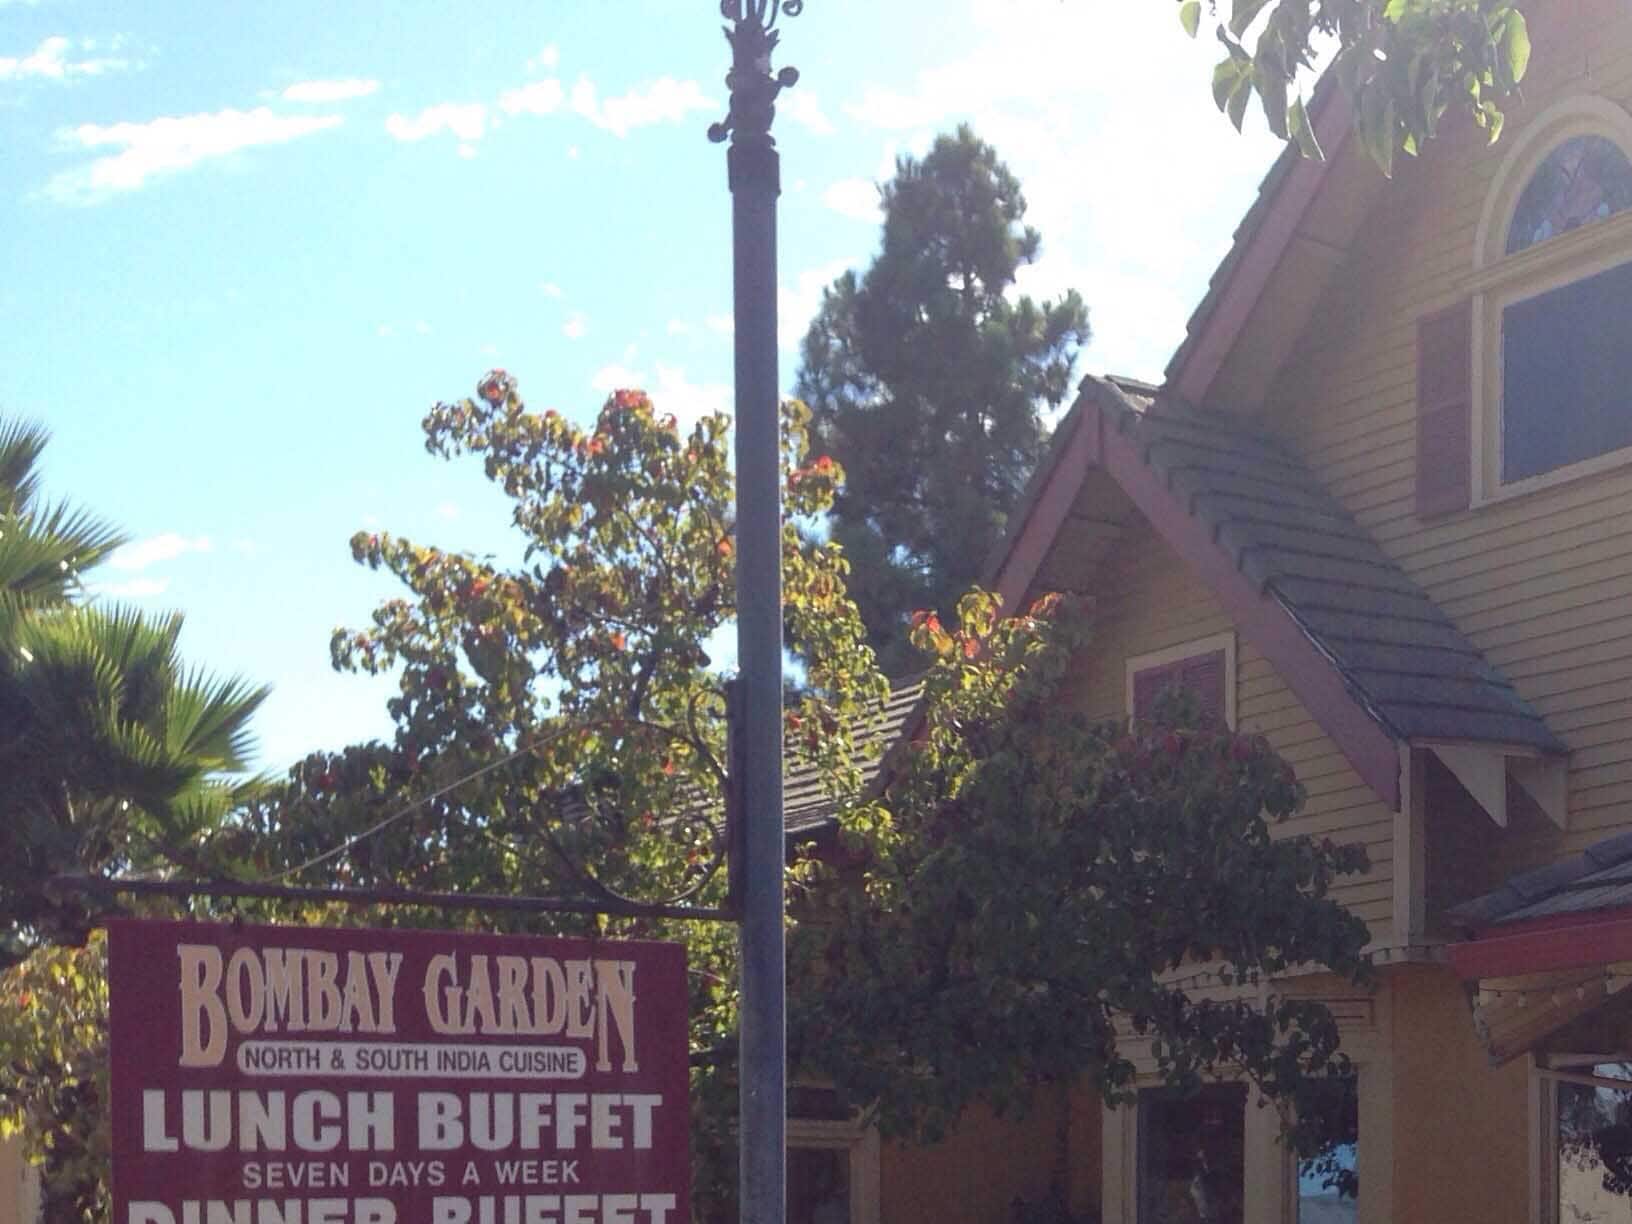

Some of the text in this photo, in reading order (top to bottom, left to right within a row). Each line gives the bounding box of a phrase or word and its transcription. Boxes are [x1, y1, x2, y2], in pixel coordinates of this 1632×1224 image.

[177, 944, 638, 1072] BOMBAY GARDEN
[244, 1047, 579, 1073] NORTH & SOUTH INDIA CUISINE
[143, 1090, 662, 1152] LUNCH BUFFET
[243, 1160, 580, 1190] SEVEN DAYS A WEEK
